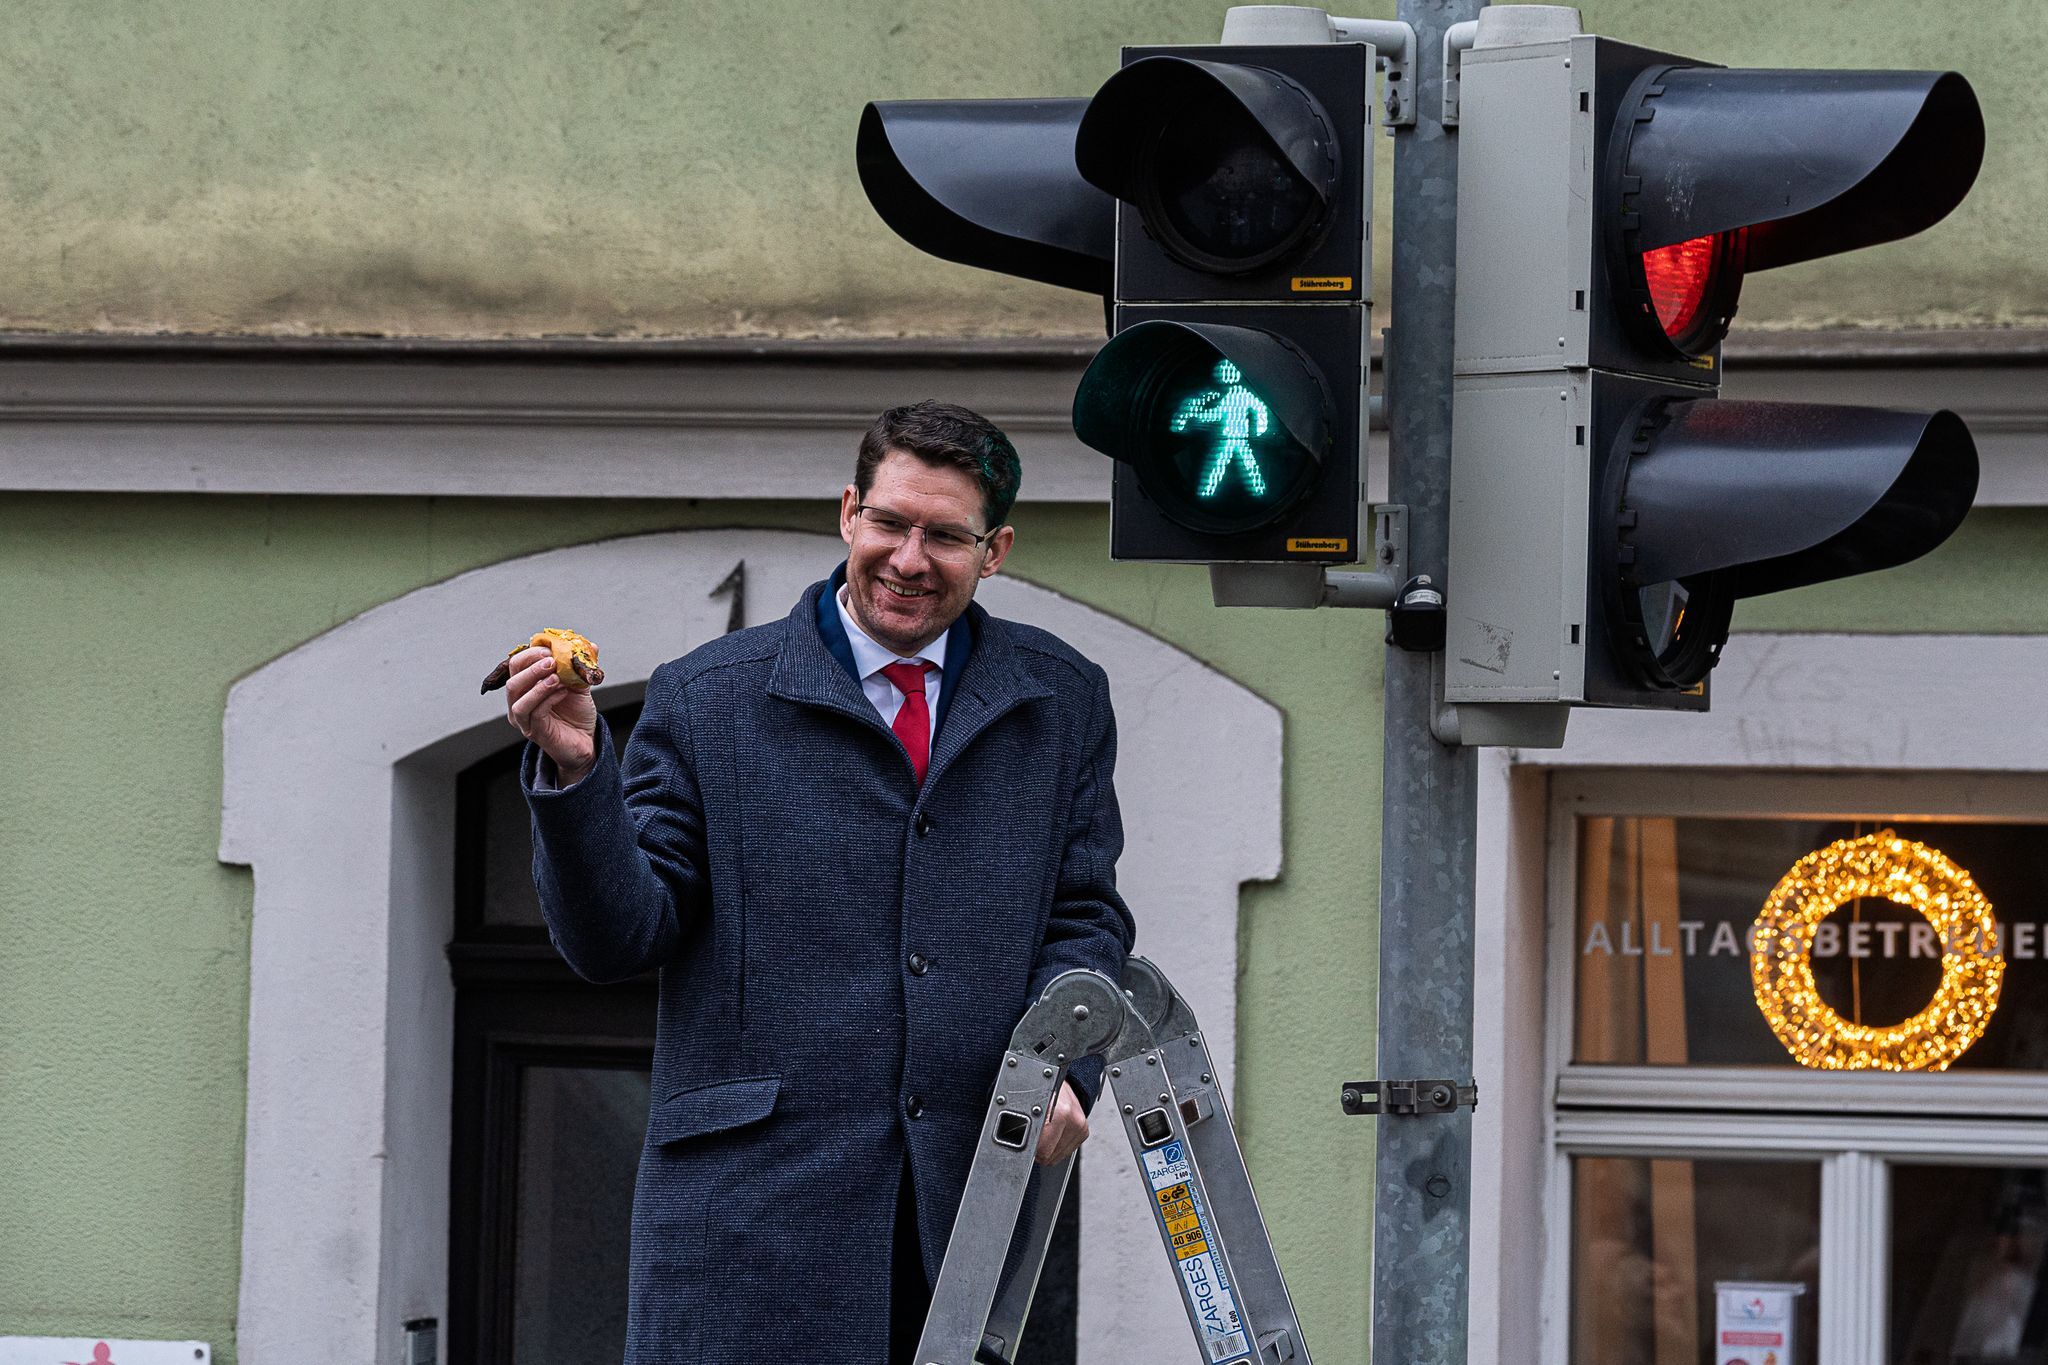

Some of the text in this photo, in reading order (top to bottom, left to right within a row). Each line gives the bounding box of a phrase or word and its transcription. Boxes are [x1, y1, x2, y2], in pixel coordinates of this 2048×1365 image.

[1300, 280, 1344, 289] Stührenberg
[1295, 541, 1340, 550] Stührenberg
[709, 559, 745, 634] 1
[1150, 1161, 1186, 1179] ZARGES
[1173, 1230, 1202, 1246] 40 906
[1186, 1257, 1225, 1335] ZARGES
[1229, 1310, 1238, 1323] 600
